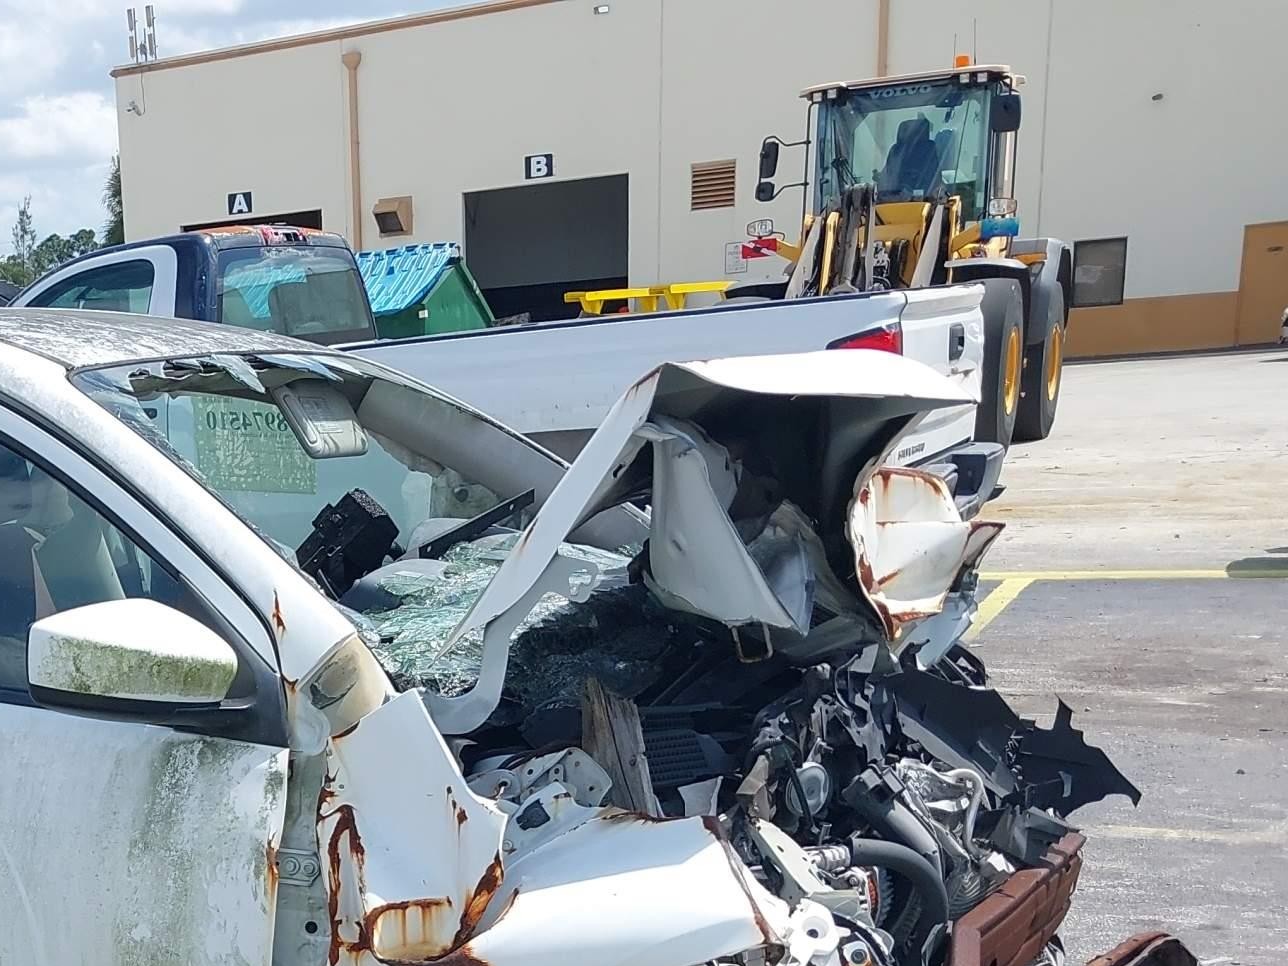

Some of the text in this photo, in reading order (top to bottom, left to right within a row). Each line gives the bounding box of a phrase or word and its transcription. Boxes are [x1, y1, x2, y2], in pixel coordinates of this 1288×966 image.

[869, 85, 931, 98] VOLVO
[530, 156, 547, 177] B
[232, 194, 249, 213] A
